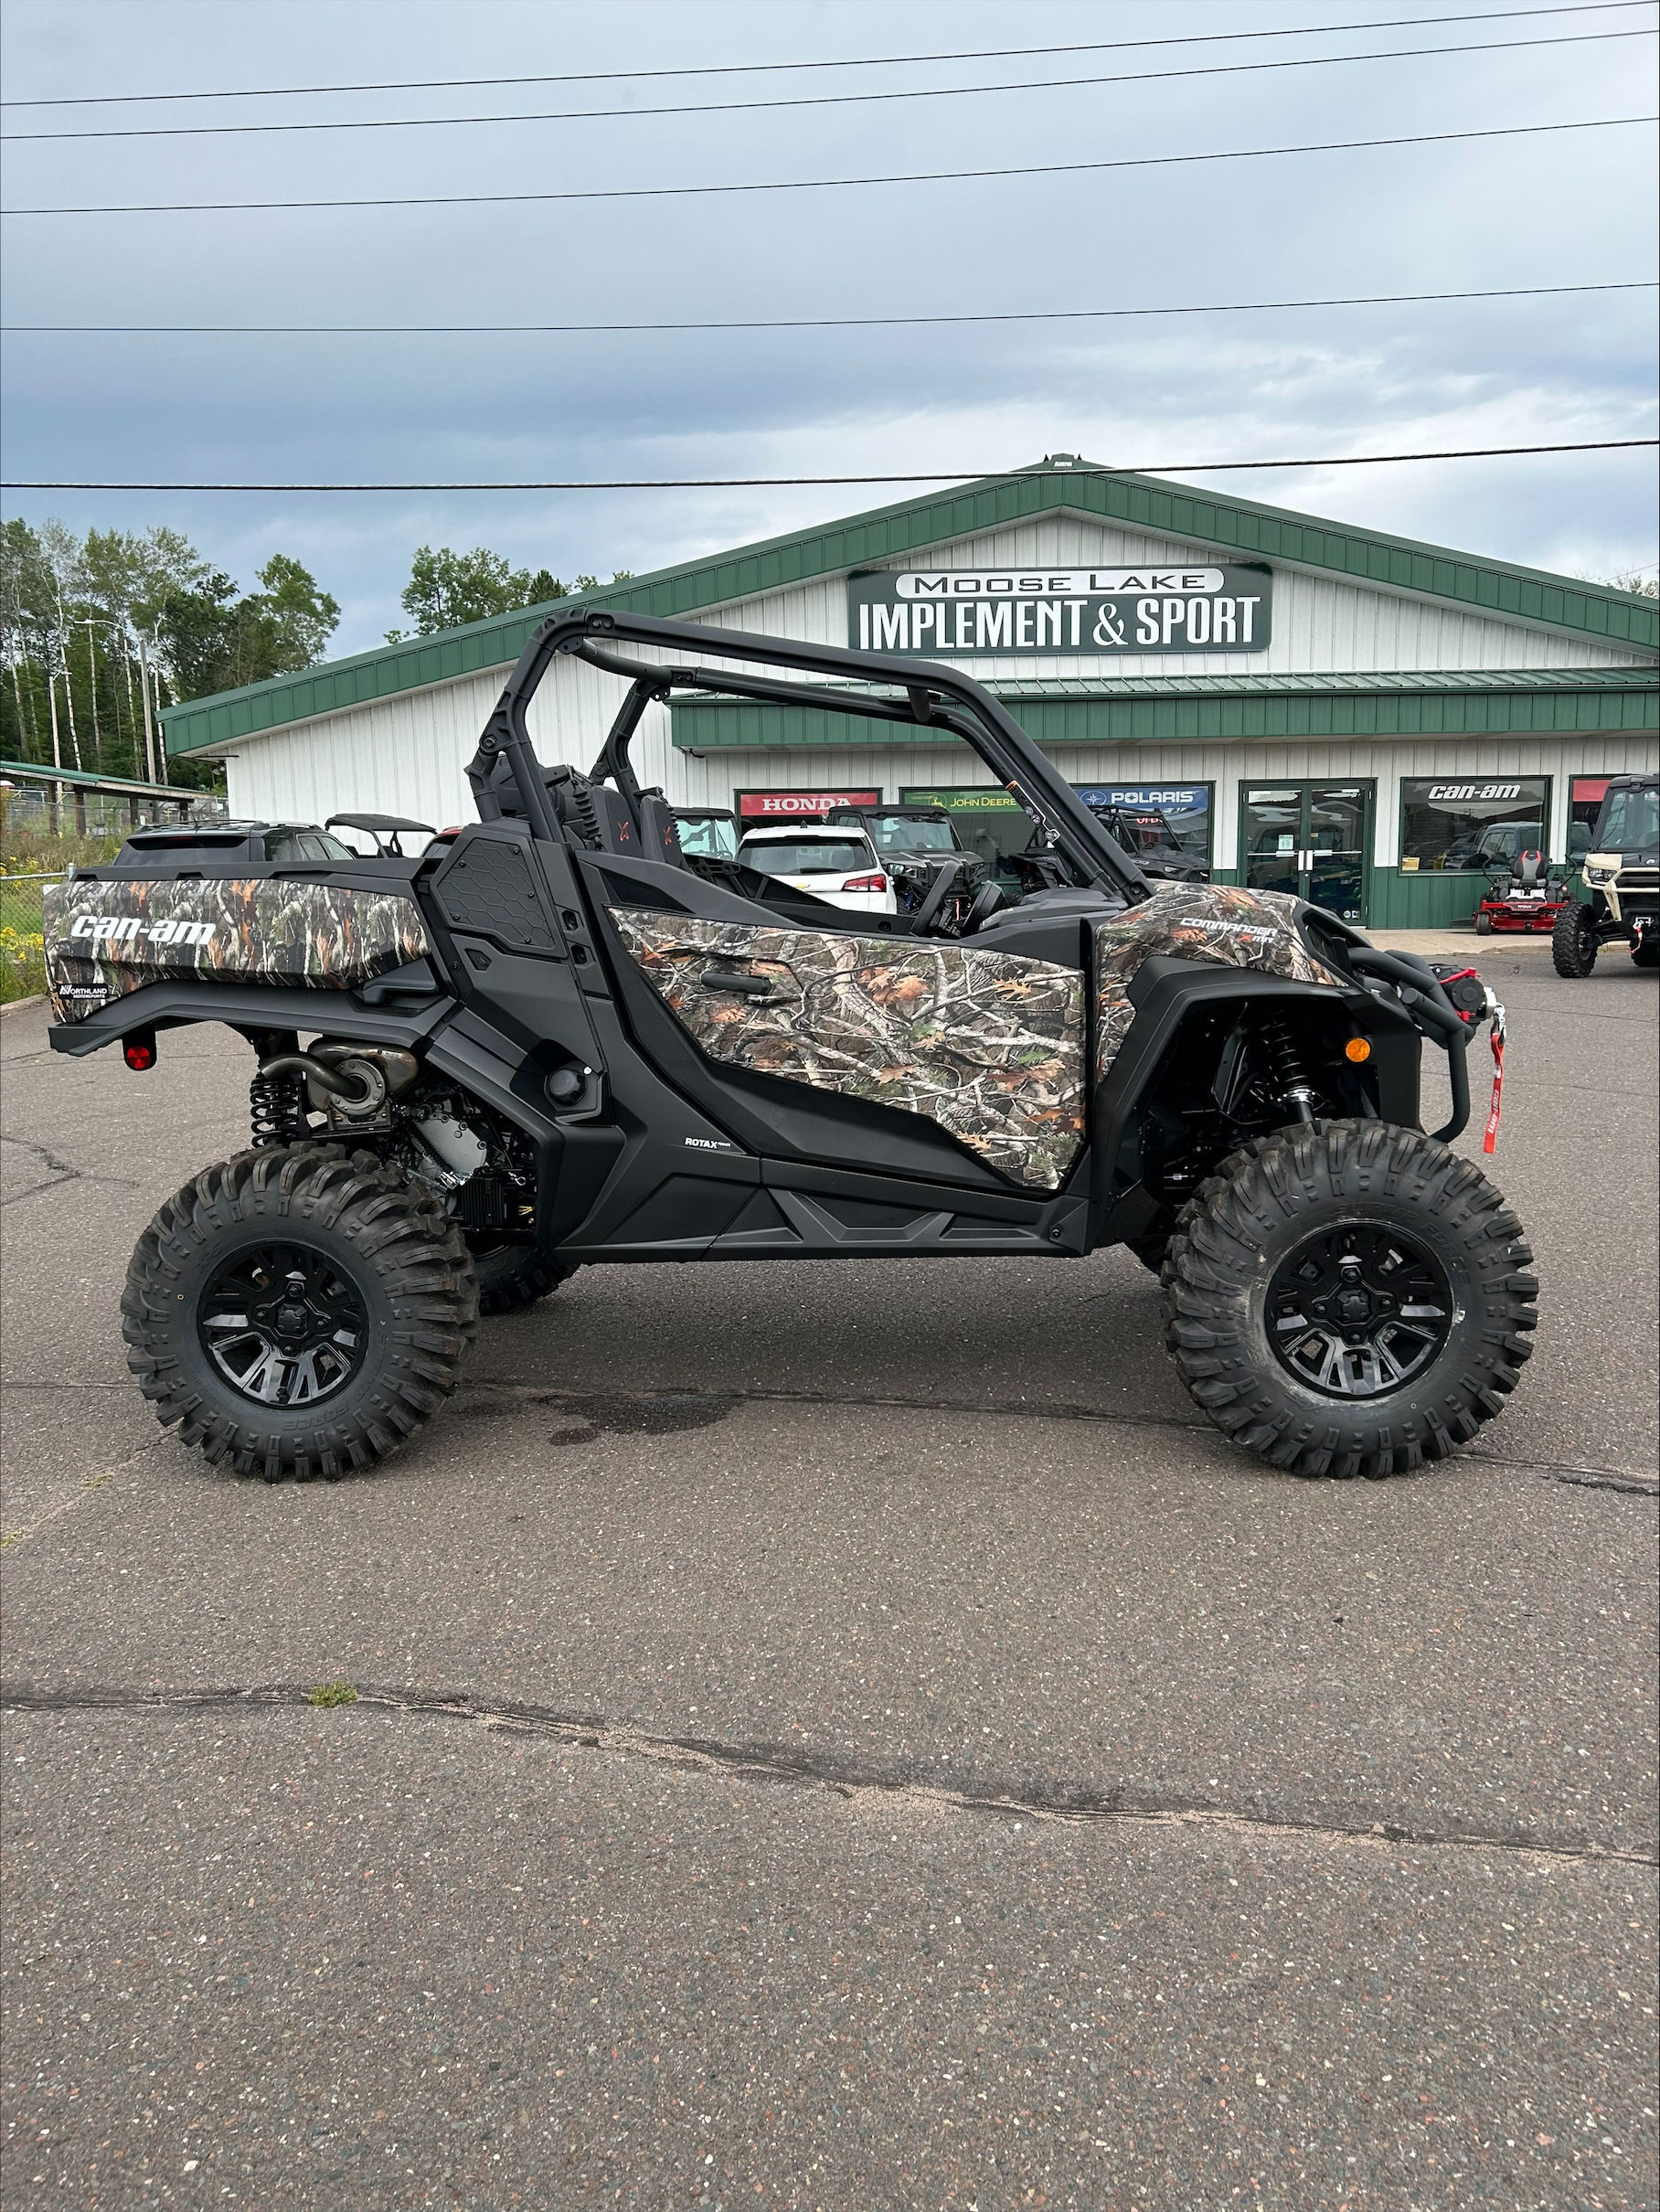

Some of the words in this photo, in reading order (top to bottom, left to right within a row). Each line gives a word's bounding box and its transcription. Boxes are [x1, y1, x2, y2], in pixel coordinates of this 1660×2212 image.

[914, 577, 1071, 594] MOOSE
[1090, 574, 1206, 590] LAKE
[859, 600, 1089, 650] IMPLEMENT
[1092, 602, 1129, 646] &
[1136, 596, 1261, 645] SPORT
[1111, 791, 1195, 804] POLARIS
[1428, 784, 1521, 800] can-am
[761, 797, 852, 811] HONDA
[950, 797, 980, 807] JOHN
[981, 797, 1017, 806] DEERE
[70, 915, 217, 945] can-am
[1180, 917, 1279, 937] COMMANDER
[59, 984, 108, 995] NORTHLAND
[685, 1137, 718, 1149] ROTAX
[283, 1406, 349, 1431] FORCE
